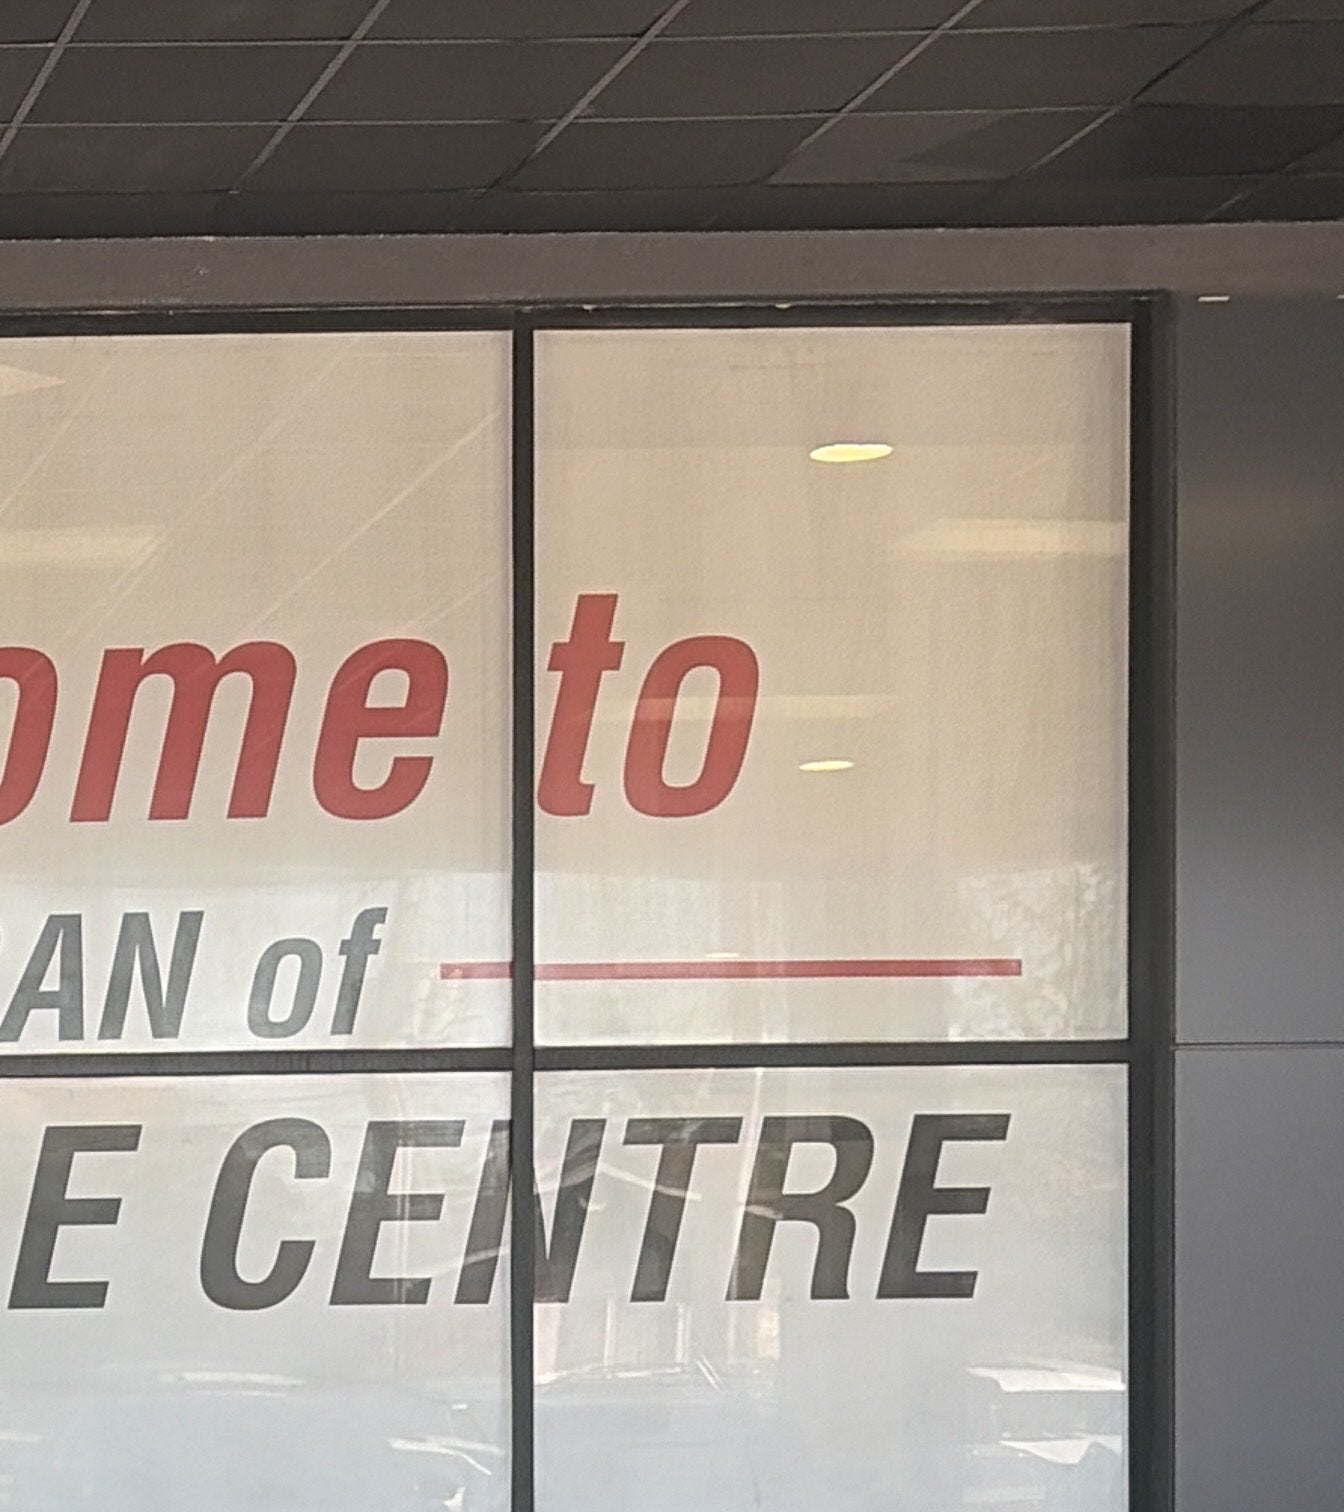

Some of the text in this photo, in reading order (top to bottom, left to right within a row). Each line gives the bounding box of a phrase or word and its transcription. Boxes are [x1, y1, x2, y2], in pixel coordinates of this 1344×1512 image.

[538, 592, 761, 819] to
[249, 906, 387, 1041] of
[200, 1112, 1011, 1309] CENTRE
